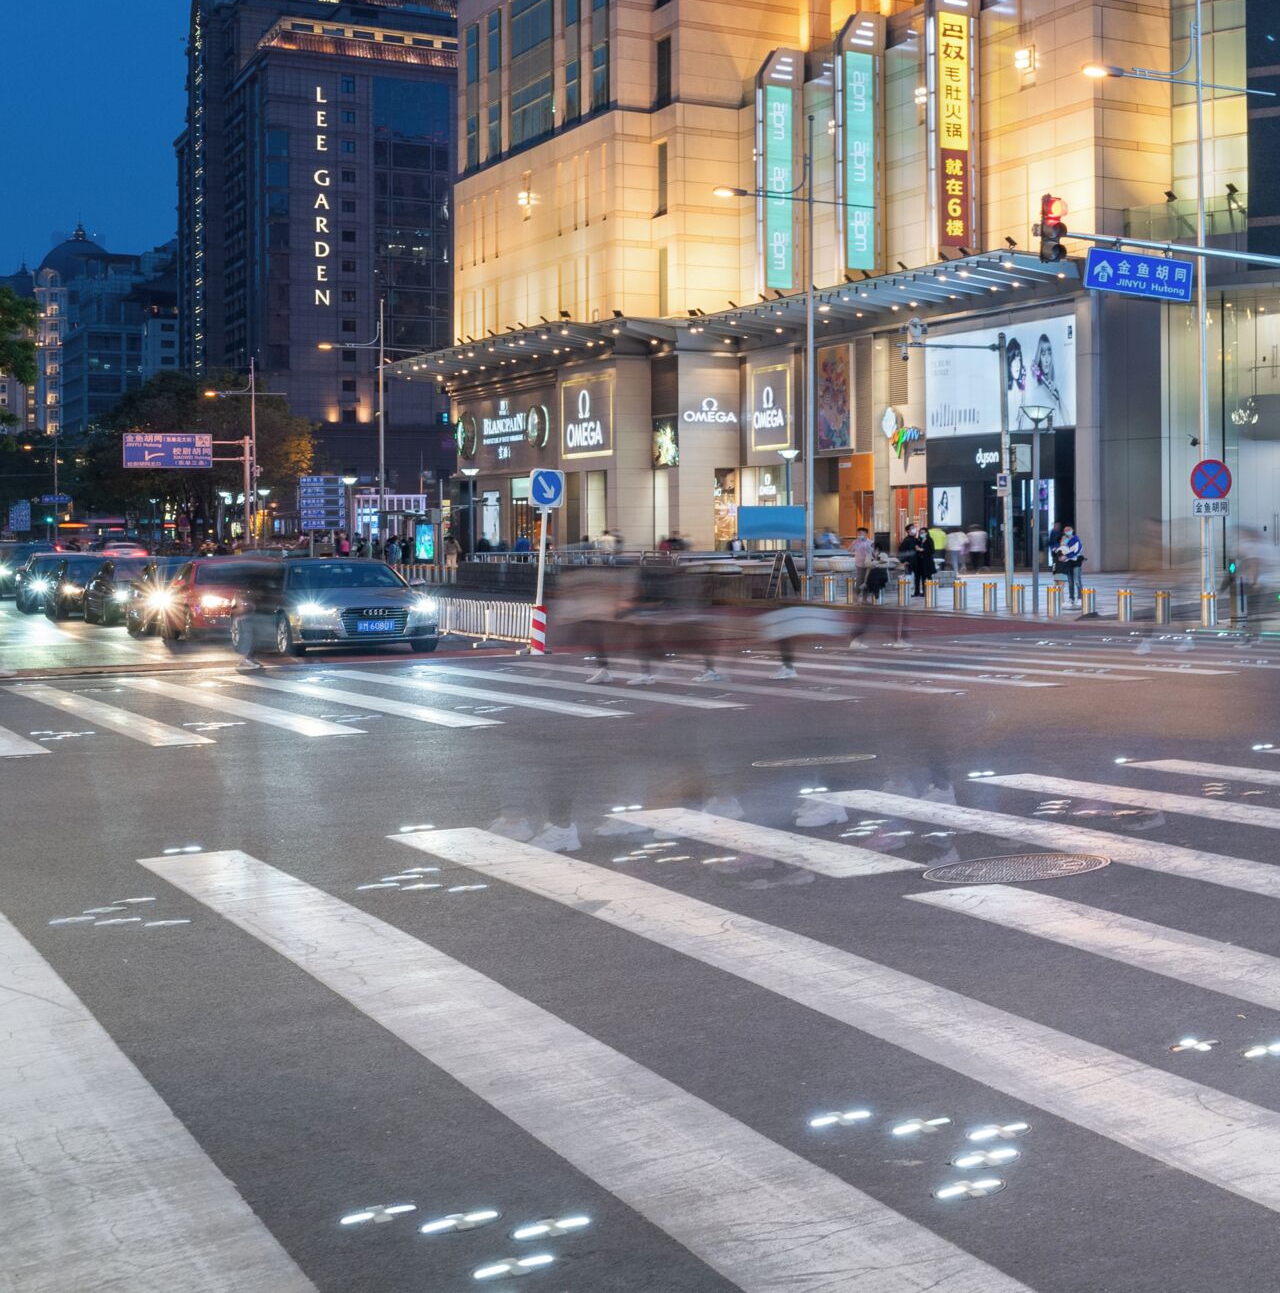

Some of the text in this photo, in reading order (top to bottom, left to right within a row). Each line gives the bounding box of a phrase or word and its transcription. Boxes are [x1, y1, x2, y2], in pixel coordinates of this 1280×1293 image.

[941, 22, 965, 139] 巴奴毛肚火锅
[314, 86, 330, 306] LEE GARDEN
[945, 159, 965, 237] 就在6楼
[1117, 259, 1187, 283] 金鱼胡同
[1116, 278, 1185, 296] JINYU Hutong
[483, 413, 526, 435] BLANCPAIN
[683, 411, 737, 423] OMEGA
[753, 409, 784, 429] OMEGA
[567, 421, 603, 448] OMEGA
[975, 448, 1000, 468] dyson
[1195, 501, 1228, 513] 金鱼胡同
